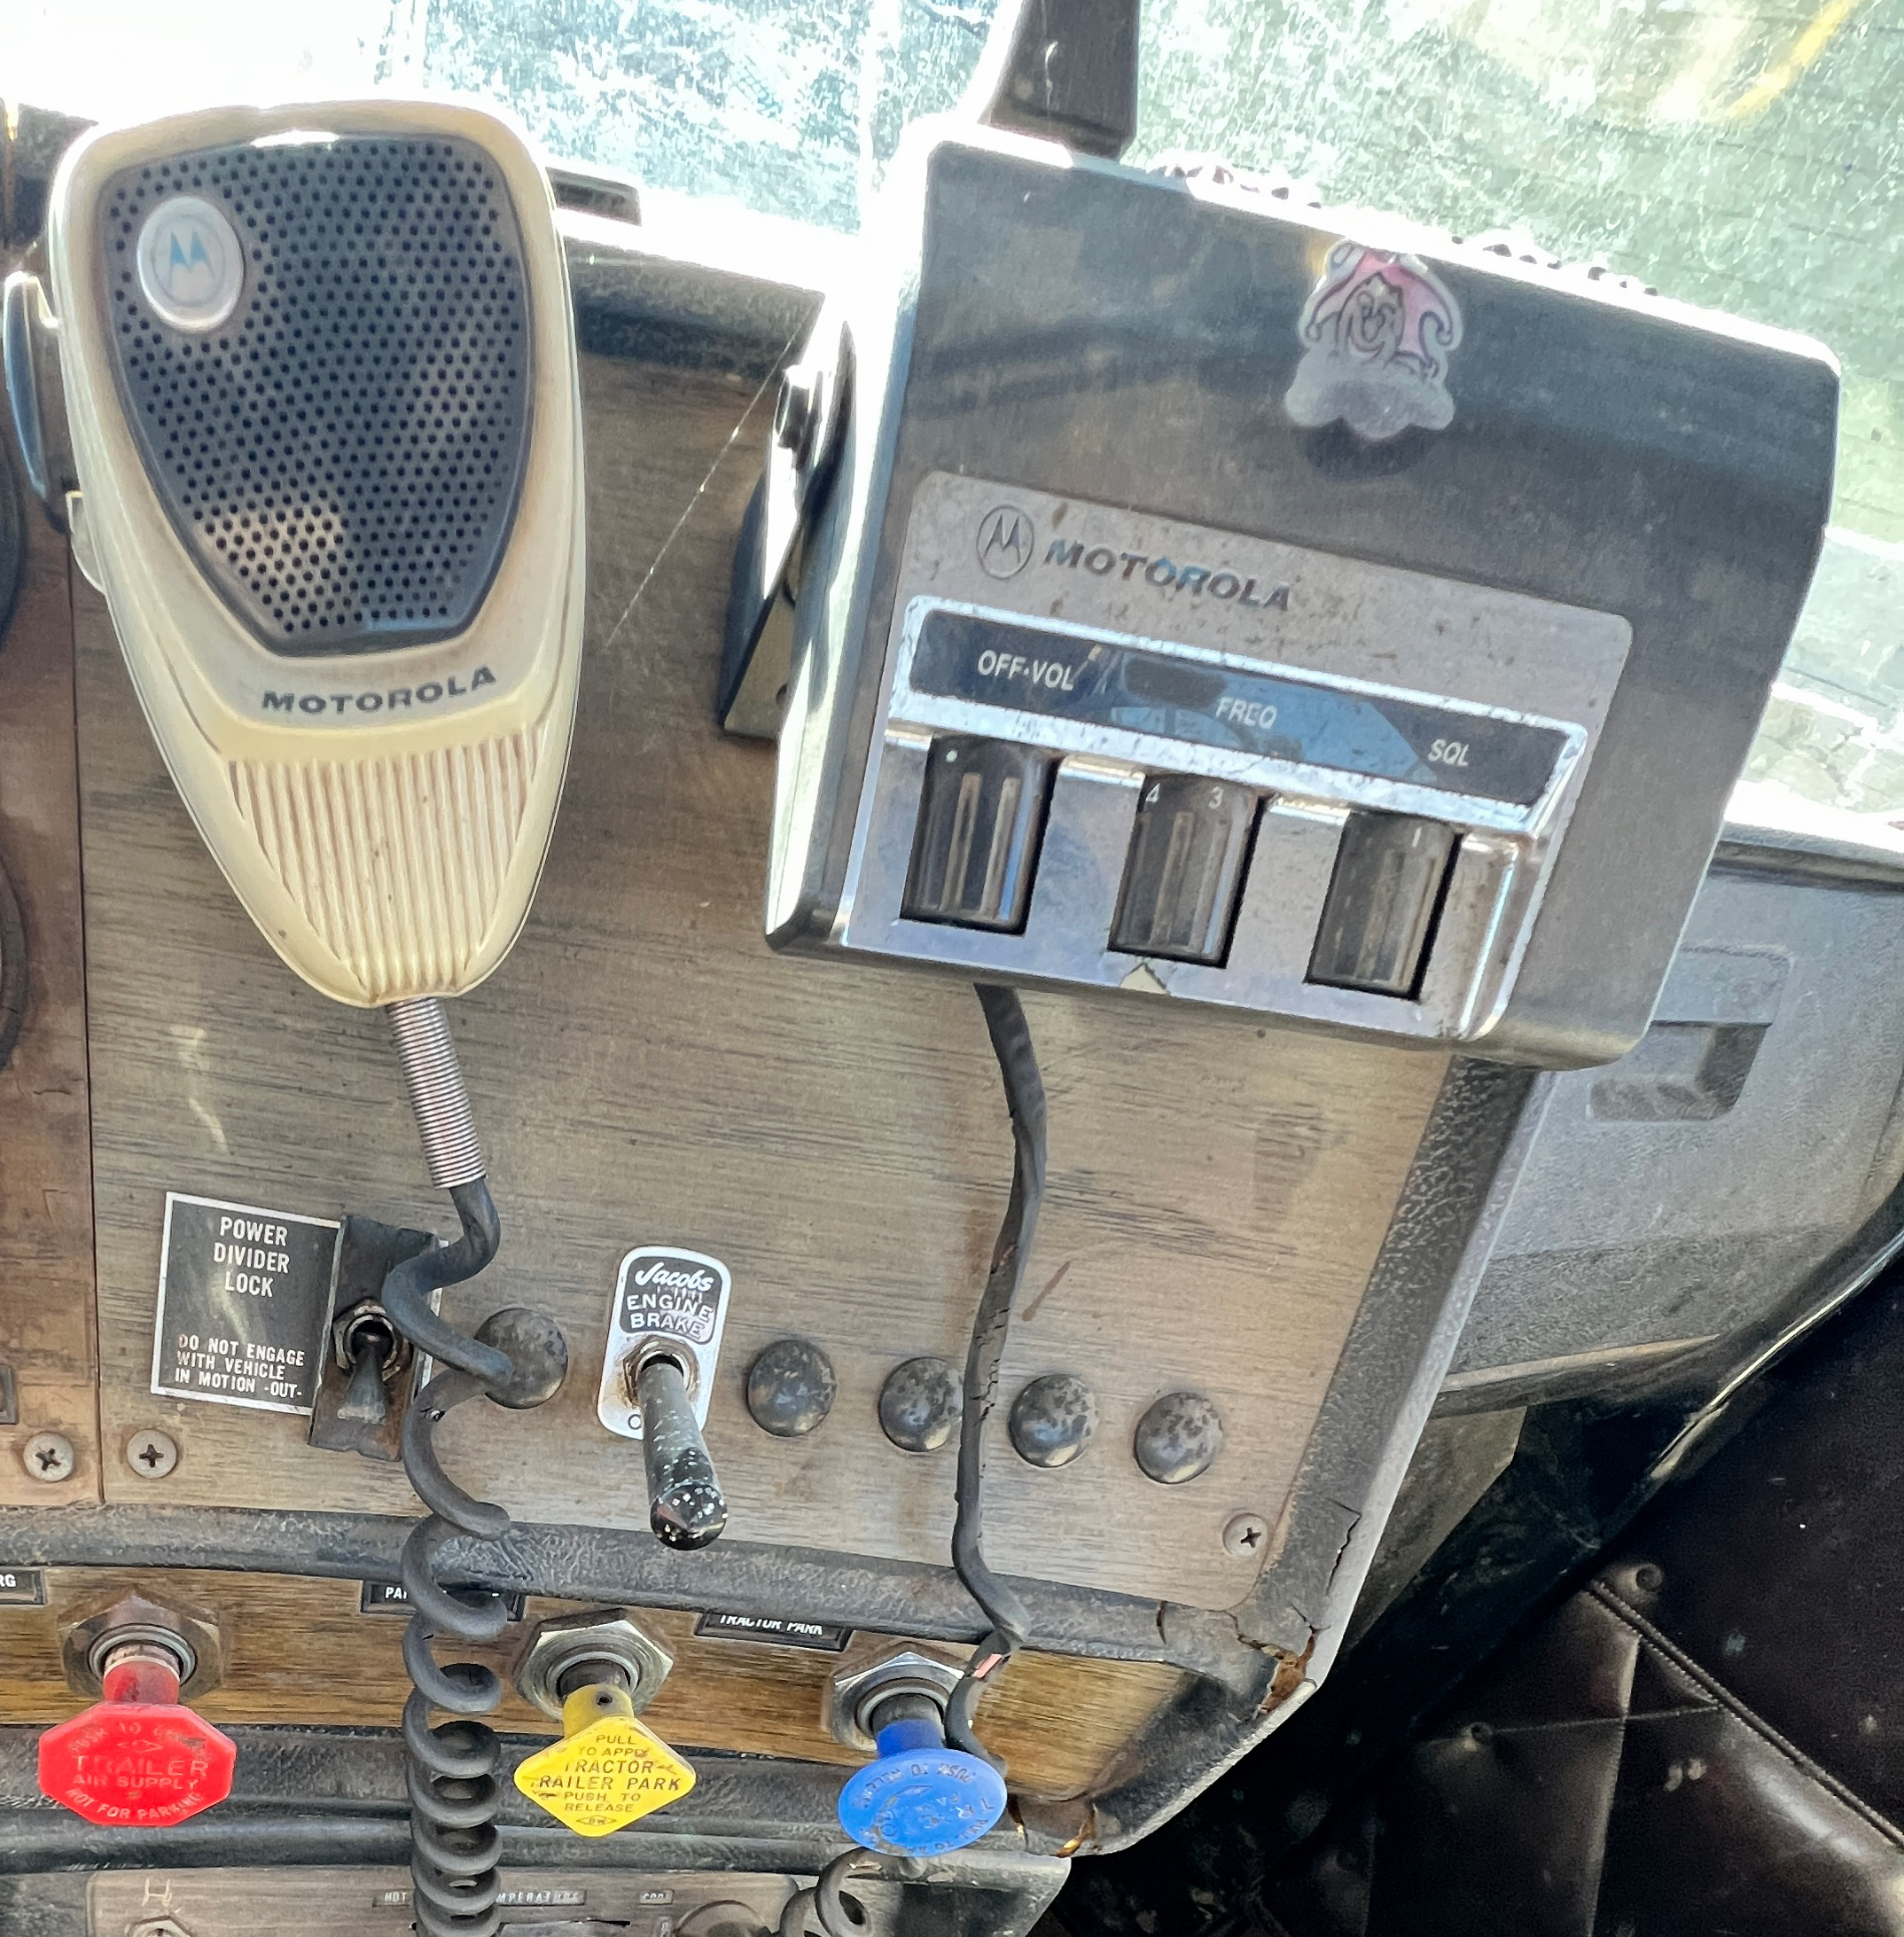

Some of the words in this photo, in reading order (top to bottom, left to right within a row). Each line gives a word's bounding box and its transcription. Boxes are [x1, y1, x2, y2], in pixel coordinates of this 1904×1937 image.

[1044, 537, 1291, 612] MOTOROLA
[261, 666, 496, 714] MOTOROLA
[1215, 695, 1278, 730] FREQ
[1427, 738, 1470, 767] SQL
[1207, 785, 1224, 809] 3
[219, 1215, 288, 1247] POWER
[213, 1242, 290, 1274] DIVIDER
[223, 1270, 274, 1298] LOCK
[634, 1261, 714, 1293] Jacobs
[626, 1293, 714, 1324] ENGINE
[630, 1312, 706, 1339] BRAKE
[178, 1334, 200, 1352] DO
[208, 1337, 239, 1355] NOT
[246, 1343, 305, 1368] ENGAGE
[177, 1350, 216, 1371] WITH
[224, 1356, 286, 1382] VEHICLE
[175, 1367, 191, 1385] IN
[198, 1372, 256, 1394] MOTION
[596, 1734, 637, 1745] PULL
[73, 1754, 209, 1777] TRAILER
[73, 1774, 108, 1786] AIR
[116, 1776, 199, 1791] SUPPLY
[530, 1775, 613, 1791] RAILER
[626, 1777, 682, 1792] PARK
[563, 1791, 608, 1801] PUSH
[620, 1793, 642, 1801] TO
[66, 1786, 96, 1808] NOT
[97, 1803, 132, 1819] FOR
[137, 1792, 204, 1821] PARKING
[564, 1802, 635, 1813] RELEASE
[384, 1891, 409, 1903] HOT
